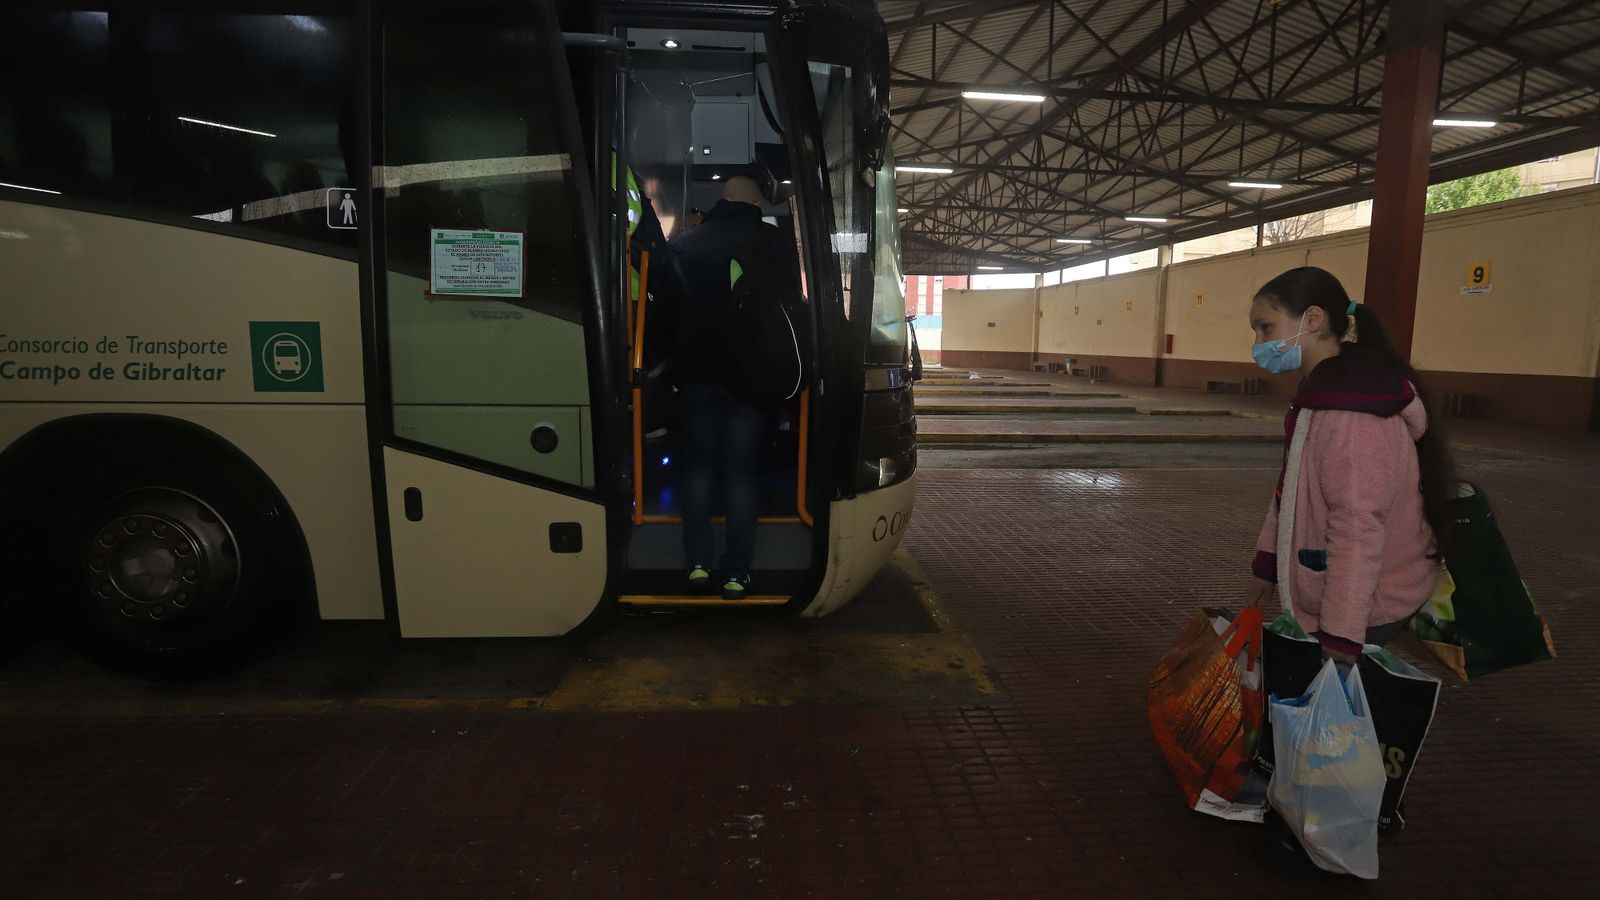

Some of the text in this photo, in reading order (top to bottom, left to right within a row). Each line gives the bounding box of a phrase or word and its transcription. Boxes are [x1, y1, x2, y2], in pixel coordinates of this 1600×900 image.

[1473, 266, 1484, 283] 9
[470, 310, 523, 320] VOLVO
[0, 334, 228, 359] Consorcio de Transporte
[0, 361, 226, 385] Campo de Gibraltar
